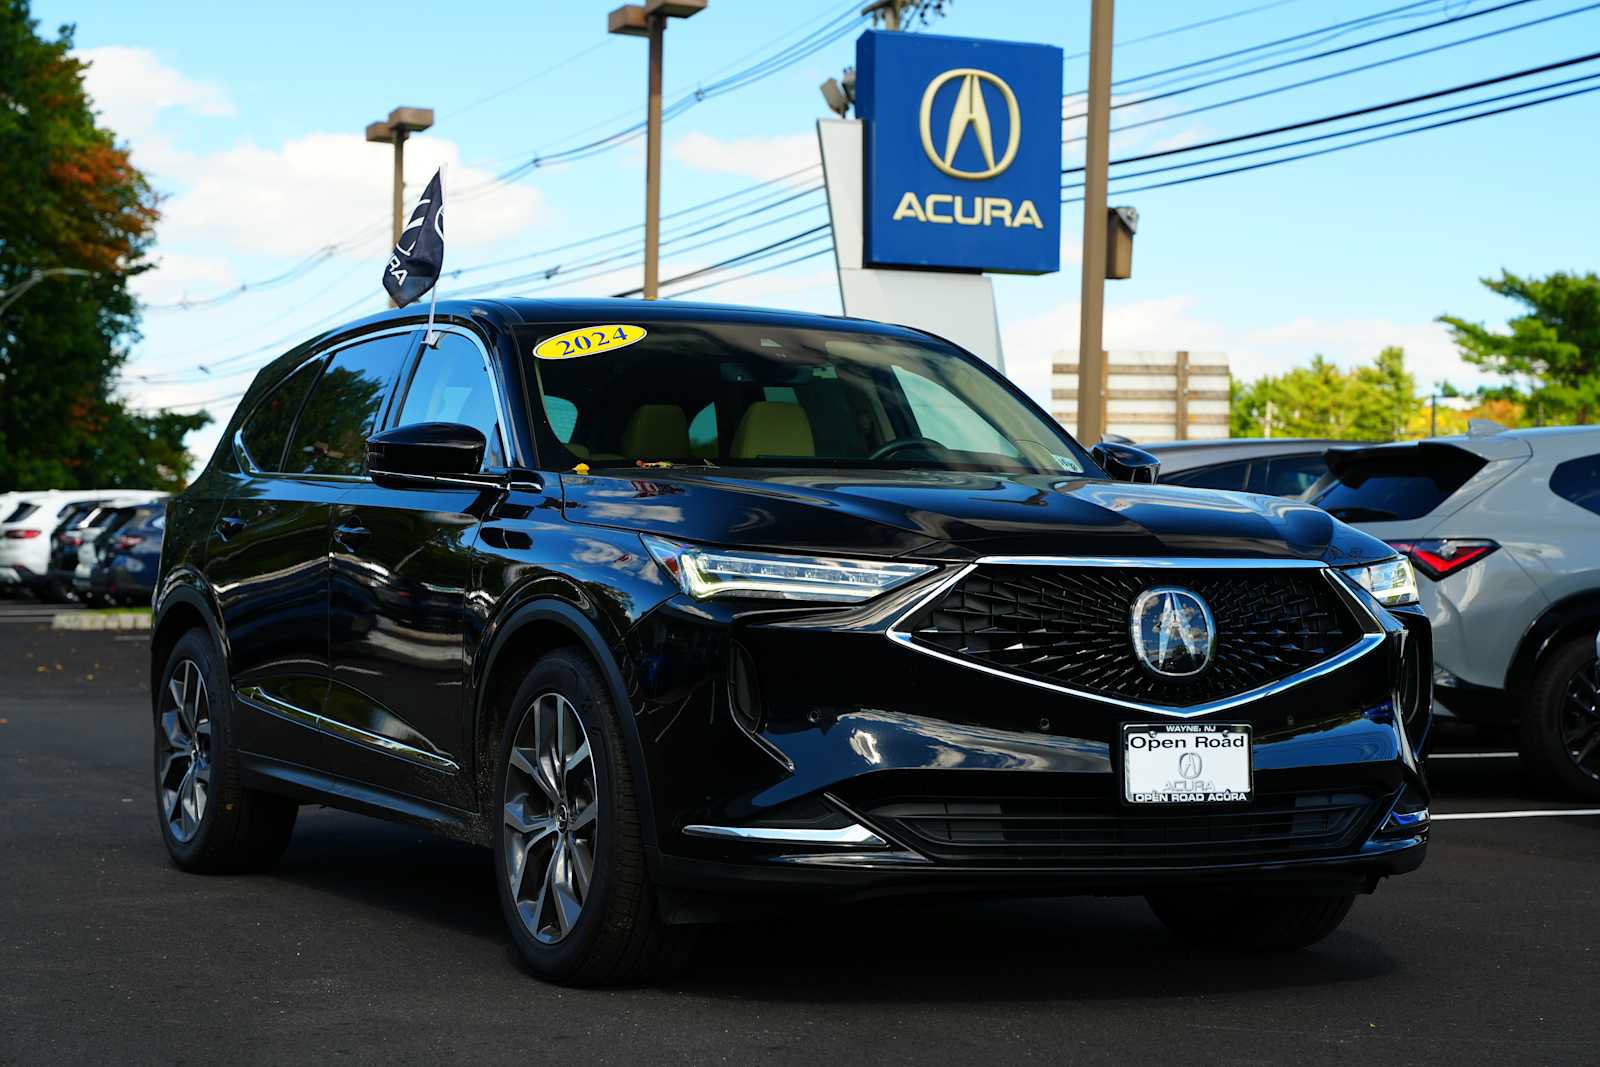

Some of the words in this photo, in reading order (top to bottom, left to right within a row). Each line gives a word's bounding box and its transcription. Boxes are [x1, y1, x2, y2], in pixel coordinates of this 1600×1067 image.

[892, 191, 1044, 229] ACURA
[555, 327, 628, 356] 2024
[1130, 736, 1186, 752] Open
[1195, 736, 1244, 748] Road
[1162, 780, 1216, 792] ACURA
[1135, 793, 1168, 802] OPEN
[1171, 793, 1205, 802] ROAD
[1207, 792, 1247, 802] ACURA
